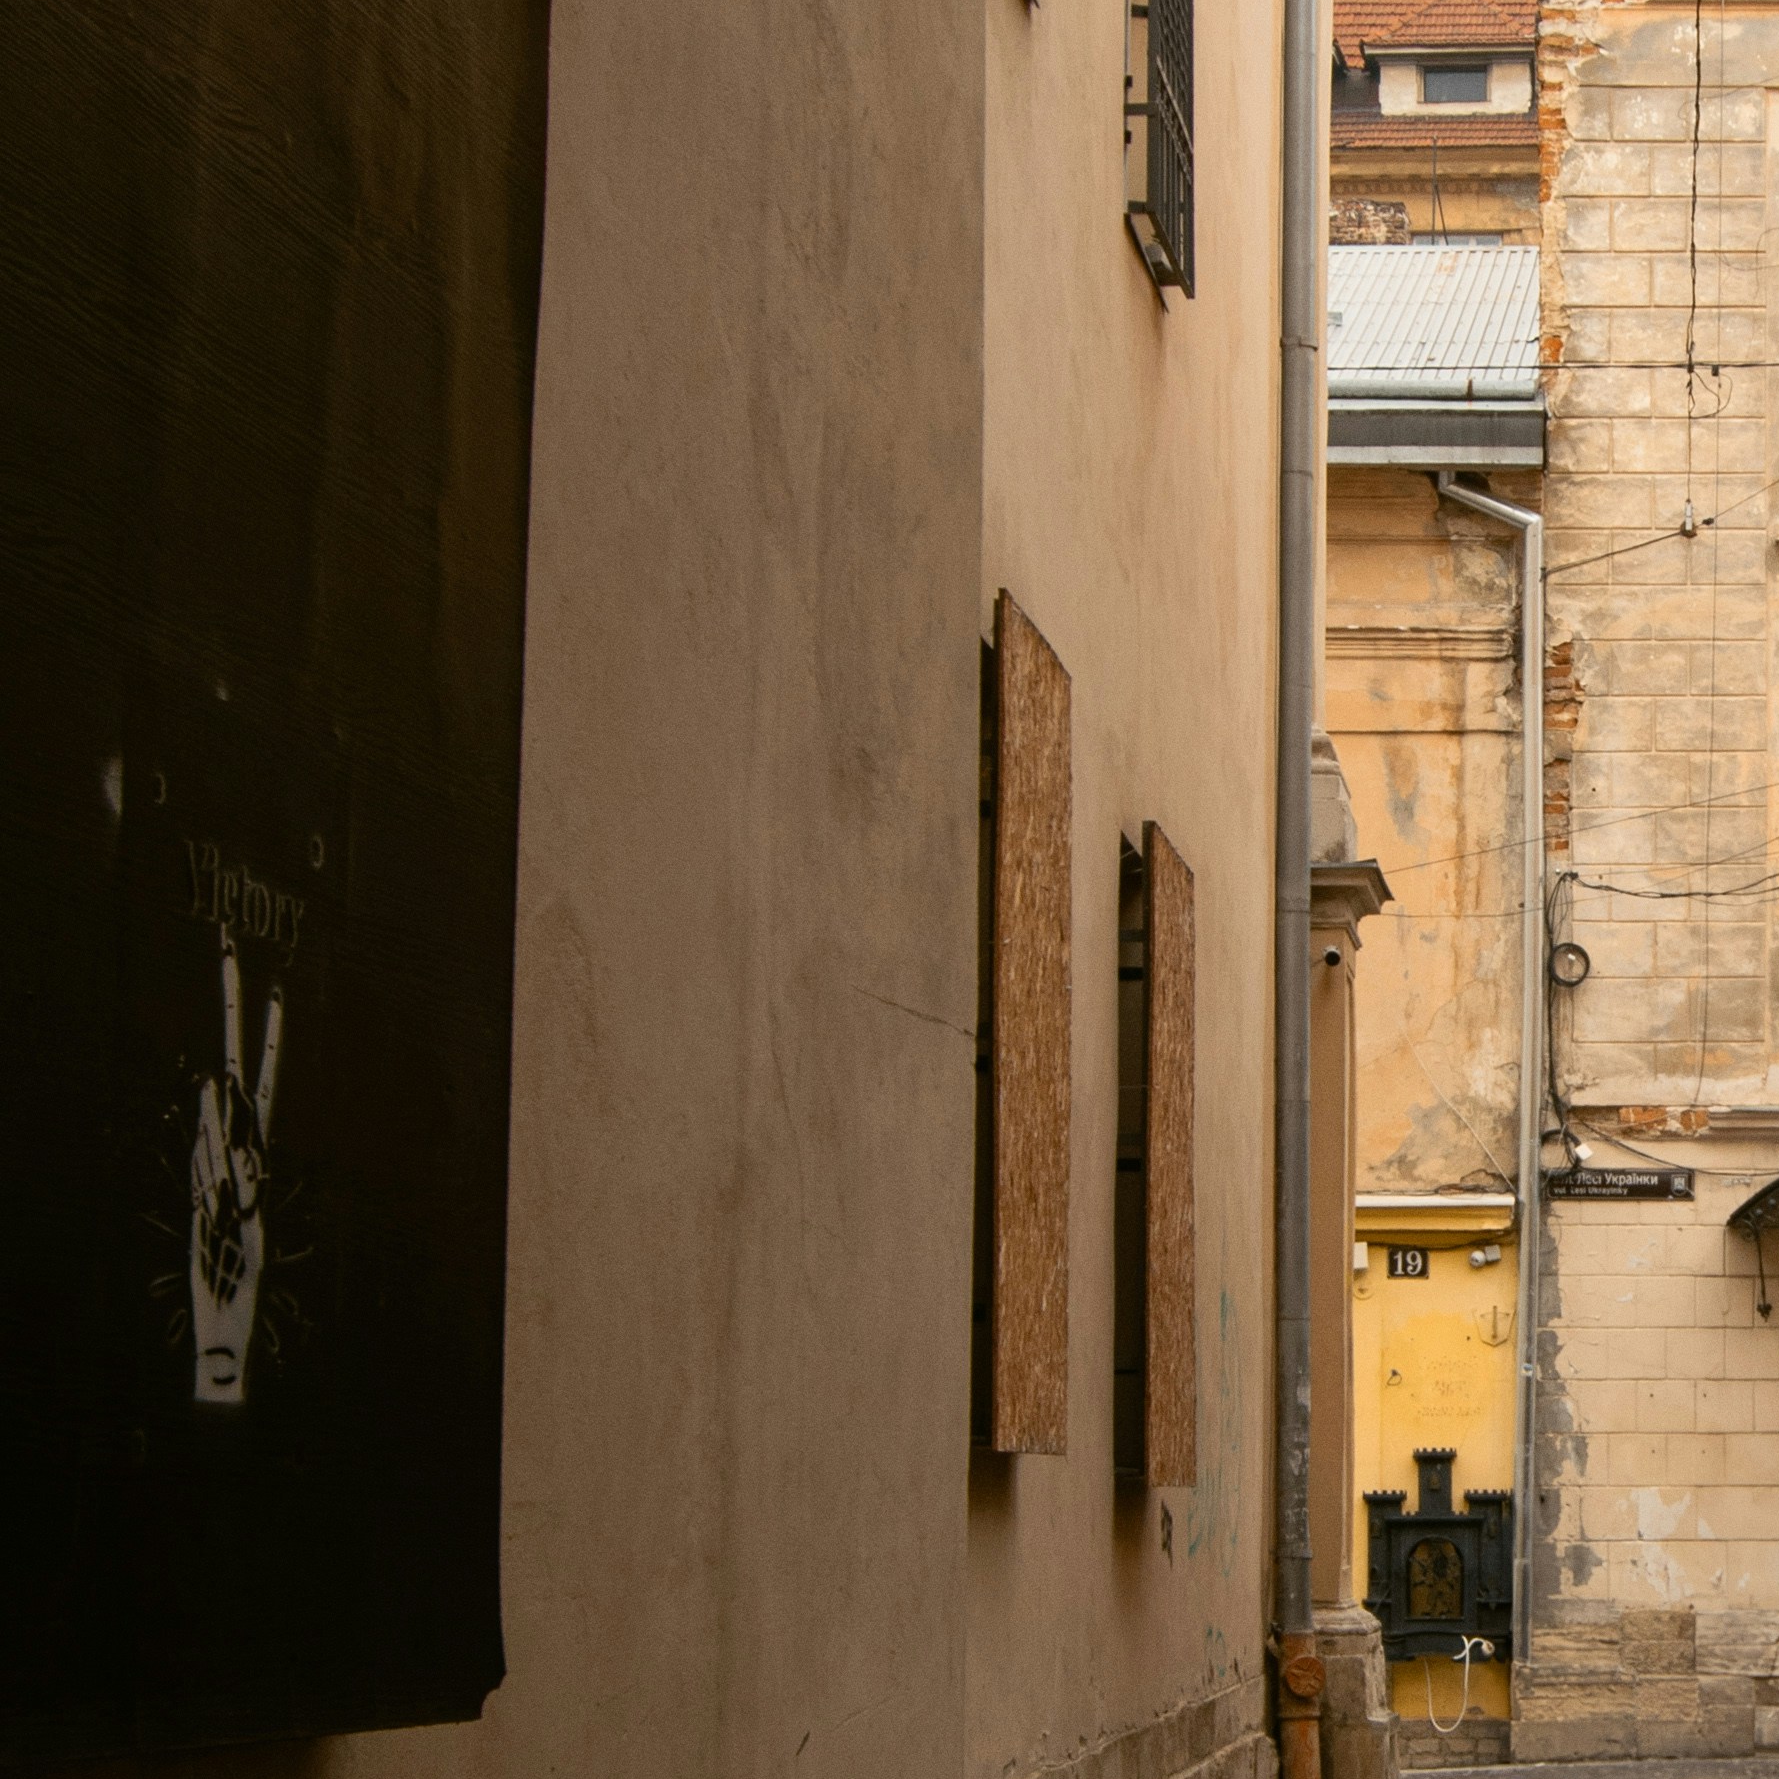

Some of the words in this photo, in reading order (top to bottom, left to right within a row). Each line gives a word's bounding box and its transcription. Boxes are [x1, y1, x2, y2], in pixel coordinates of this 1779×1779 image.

[1577, 1172, 1602, 1185] Лесі
[1605, 1173, 1659, 1186] Українки
[1393, 1250, 1423, 1276] 19
